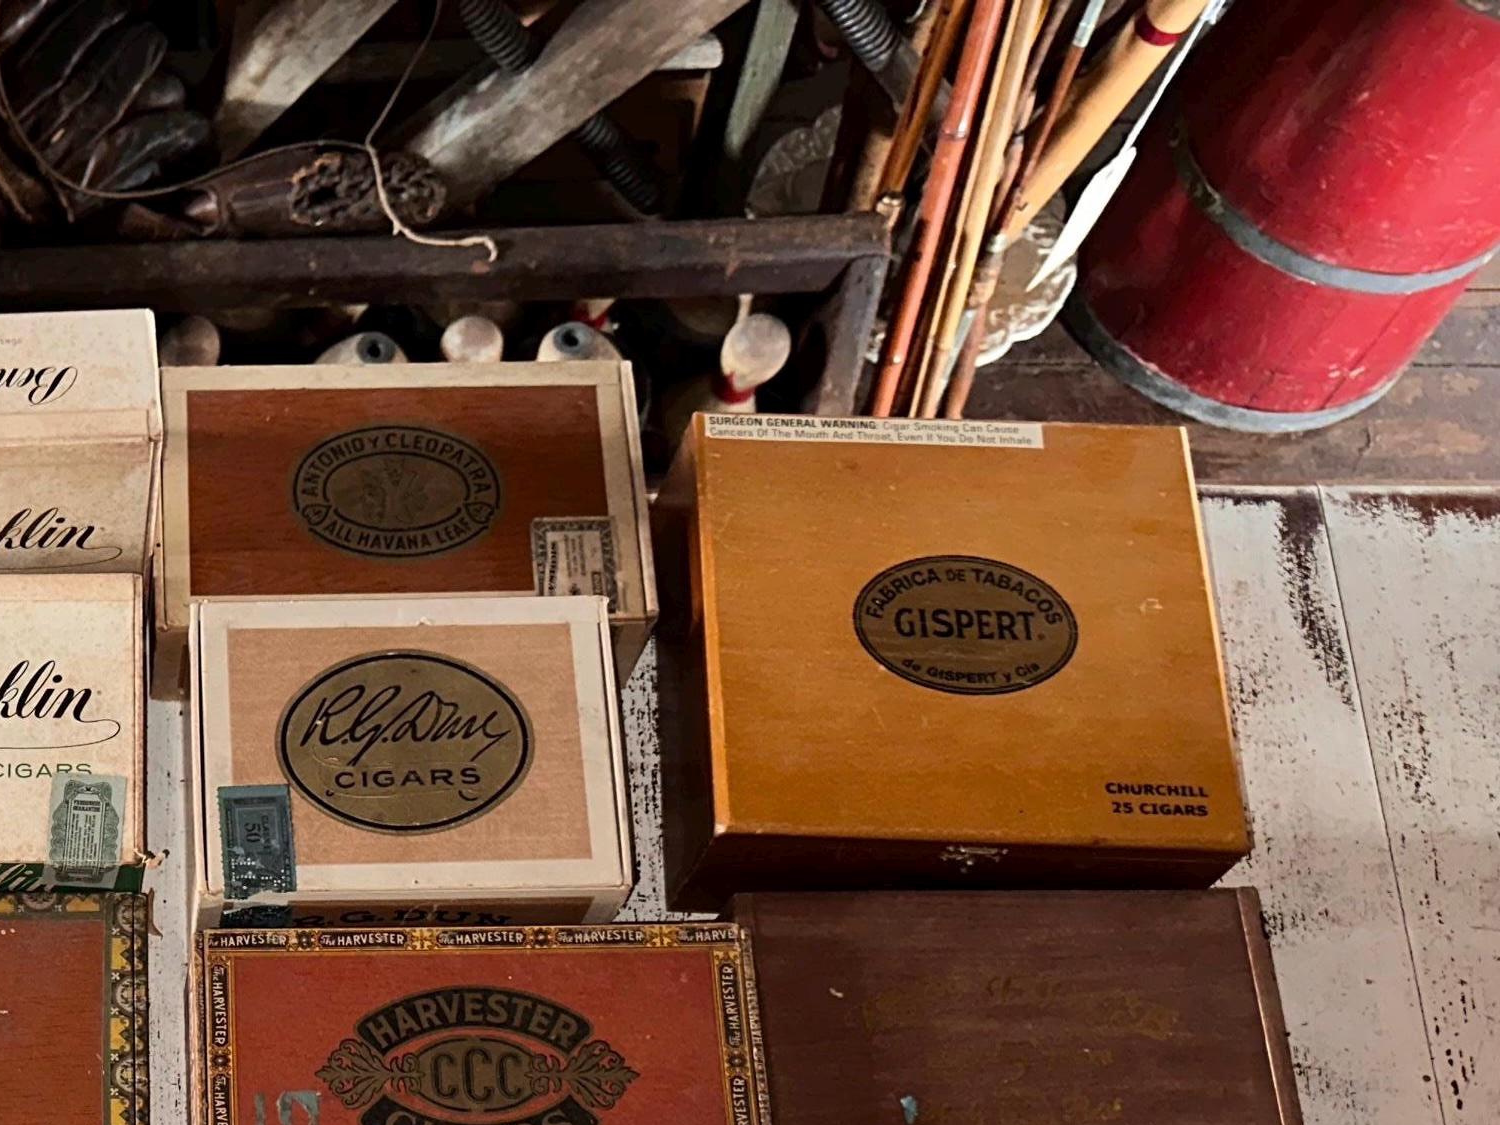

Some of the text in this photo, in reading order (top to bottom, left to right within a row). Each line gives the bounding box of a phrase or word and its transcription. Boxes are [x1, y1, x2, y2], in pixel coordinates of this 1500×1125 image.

[709, 416, 1019, 434] SURGEON GENERAL Cigar Smoking Can Cause
[709, 427, 1033, 445] Cancers Of The Mouth And Even You Do Not Inhale
[301, 432, 492, 498] ANTONIO CLEOPATRA
[324, 516, 474, 552] ALL HAVANA LEAF
[865, 567, 1064, 626] FABRICA DE TABACOS
[894, 607, 1037, 642] GISPERT
[901, 658, 1013, 684] de GISPERT y
[334, 766, 482, 790] CIGARS
[1105, 782, 1209, 800] CHURCHILL
[1111, 801, 1209, 818] 25 CIGARS
[220, 933, 287, 947] HARVESTER
[337, 932, 405, 946] HARVESTER
[456, 931, 524, 945] HARVESTER
[574, 929, 644, 943] HARVESTER
[720, 966, 741, 1032] HARVESTER
[213, 982, 229, 1047] HARVESTER
[366, 991, 583, 1051] HARVESTER
[430, 1046, 532, 1103] CCC
